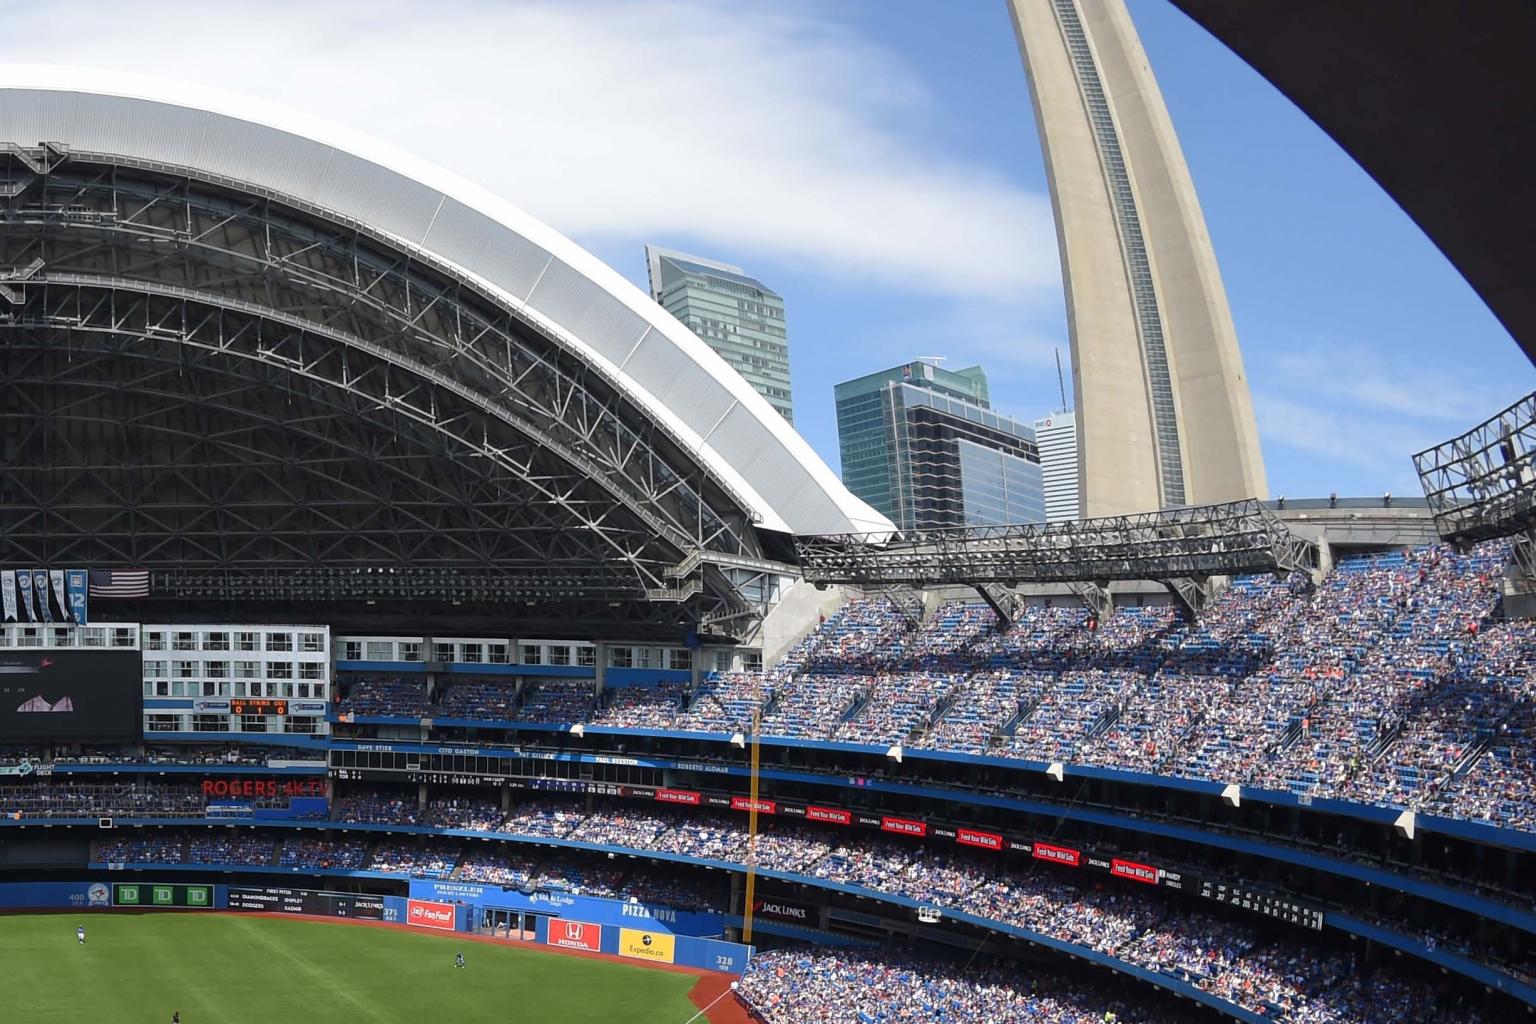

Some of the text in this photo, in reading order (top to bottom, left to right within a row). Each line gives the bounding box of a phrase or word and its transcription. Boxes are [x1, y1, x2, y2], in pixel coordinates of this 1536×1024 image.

[70, 594, 84, 607] 12
[203, 780, 329, 796] ROGERS 4K TV
[121, 888, 137, 900] TD
[155, 889, 171, 901] TD
[434, 884, 483, 894] PRESZLER
[189, 890, 205, 902] TD
[384, 908, 398, 916] 375
[622, 904, 676, 923] PIZZA NOVA
[761, 902, 782, 914] JACK
[558, 938, 589, 949] HONDA
[629, 944, 664, 957] Expedia.ca
[716, 955, 733, 966] 328
